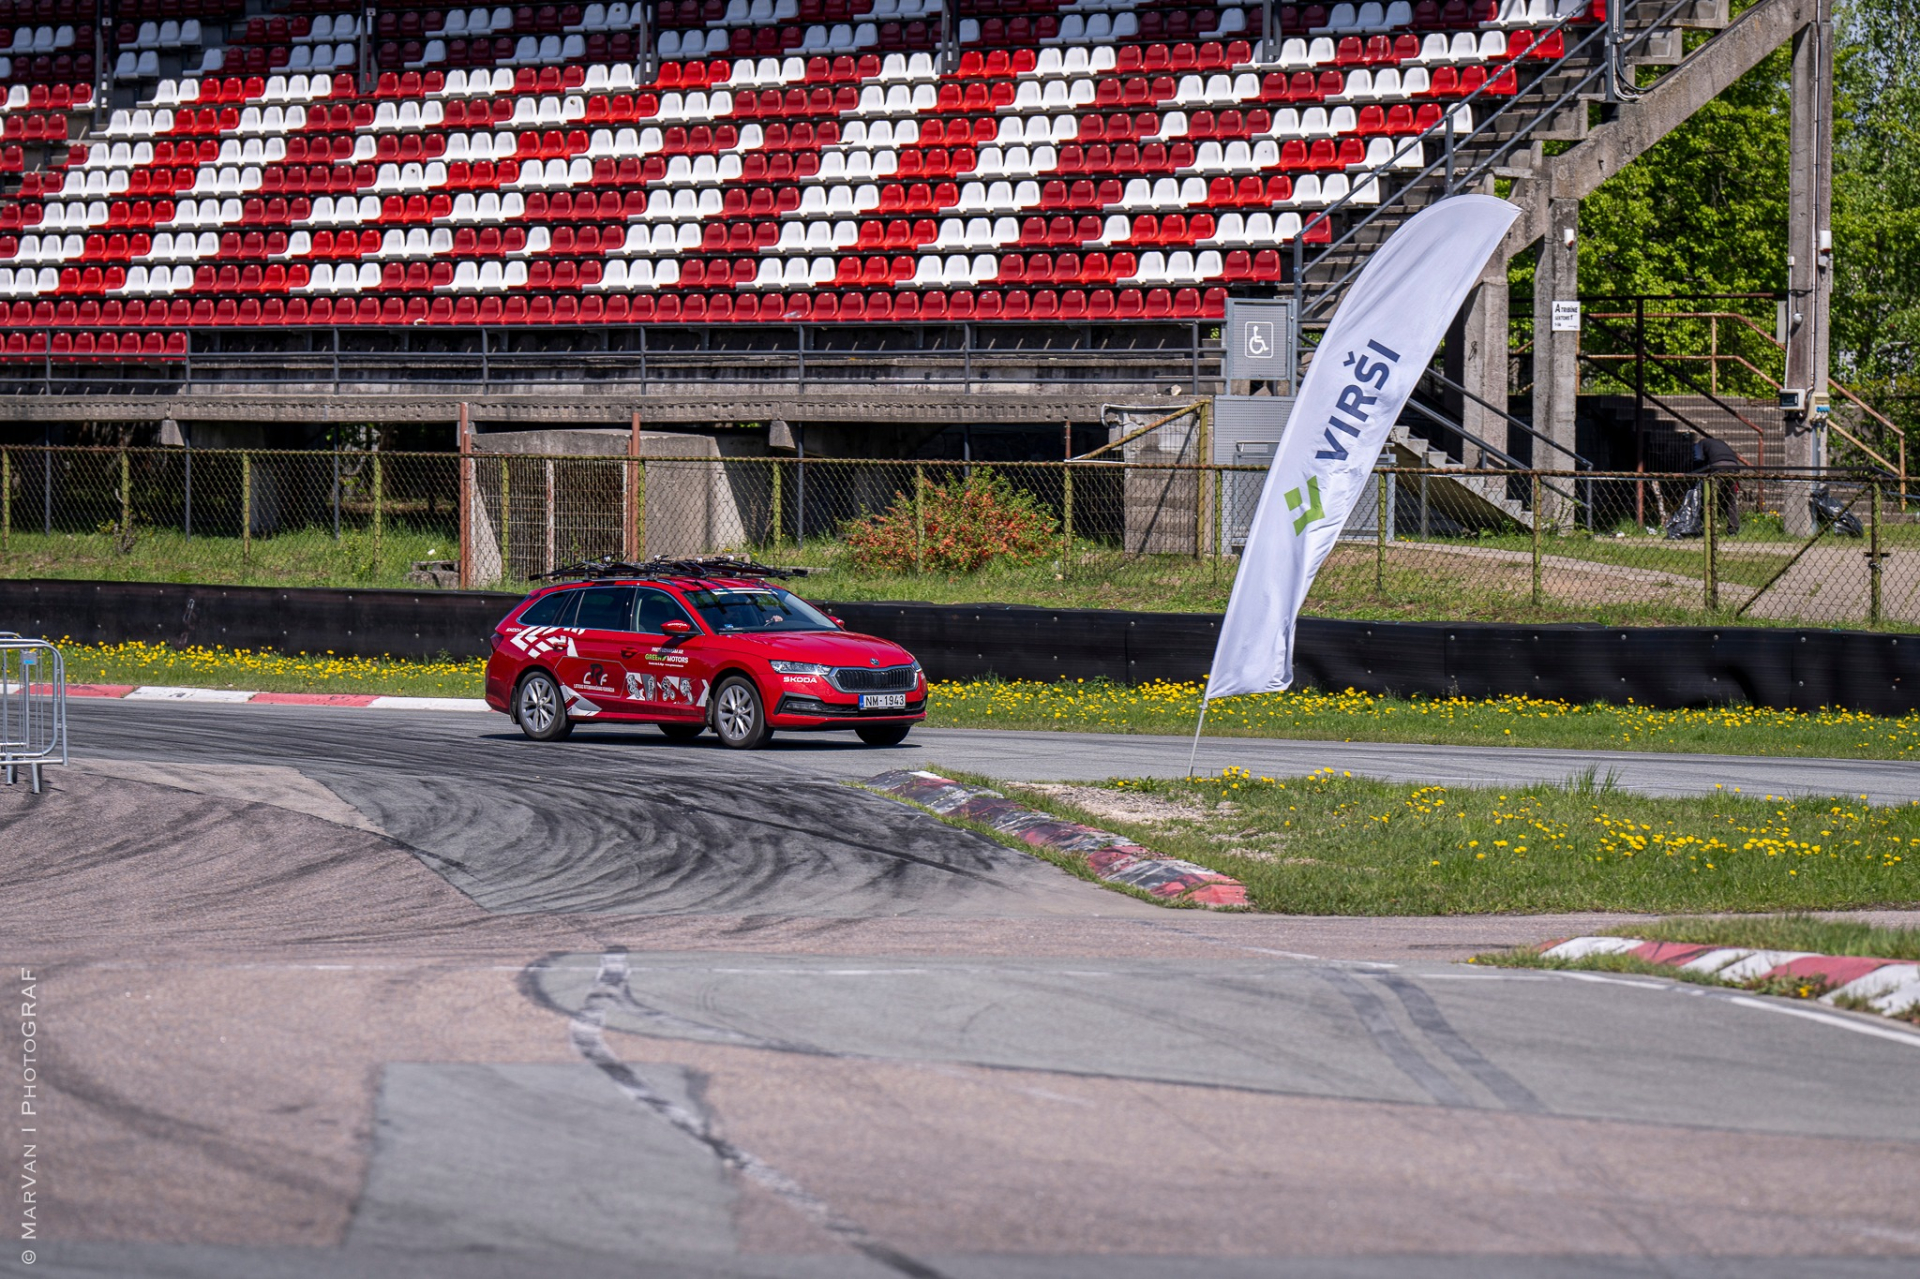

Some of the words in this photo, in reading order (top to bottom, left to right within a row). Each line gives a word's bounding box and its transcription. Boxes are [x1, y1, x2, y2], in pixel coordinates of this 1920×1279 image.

[1555, 303, 1560, 312] A
[1315, 339, 1401, 461] VIRŠI
[666, 655, 689, 664] MOTORS
[865, 695, 905, 706] NM-1943
